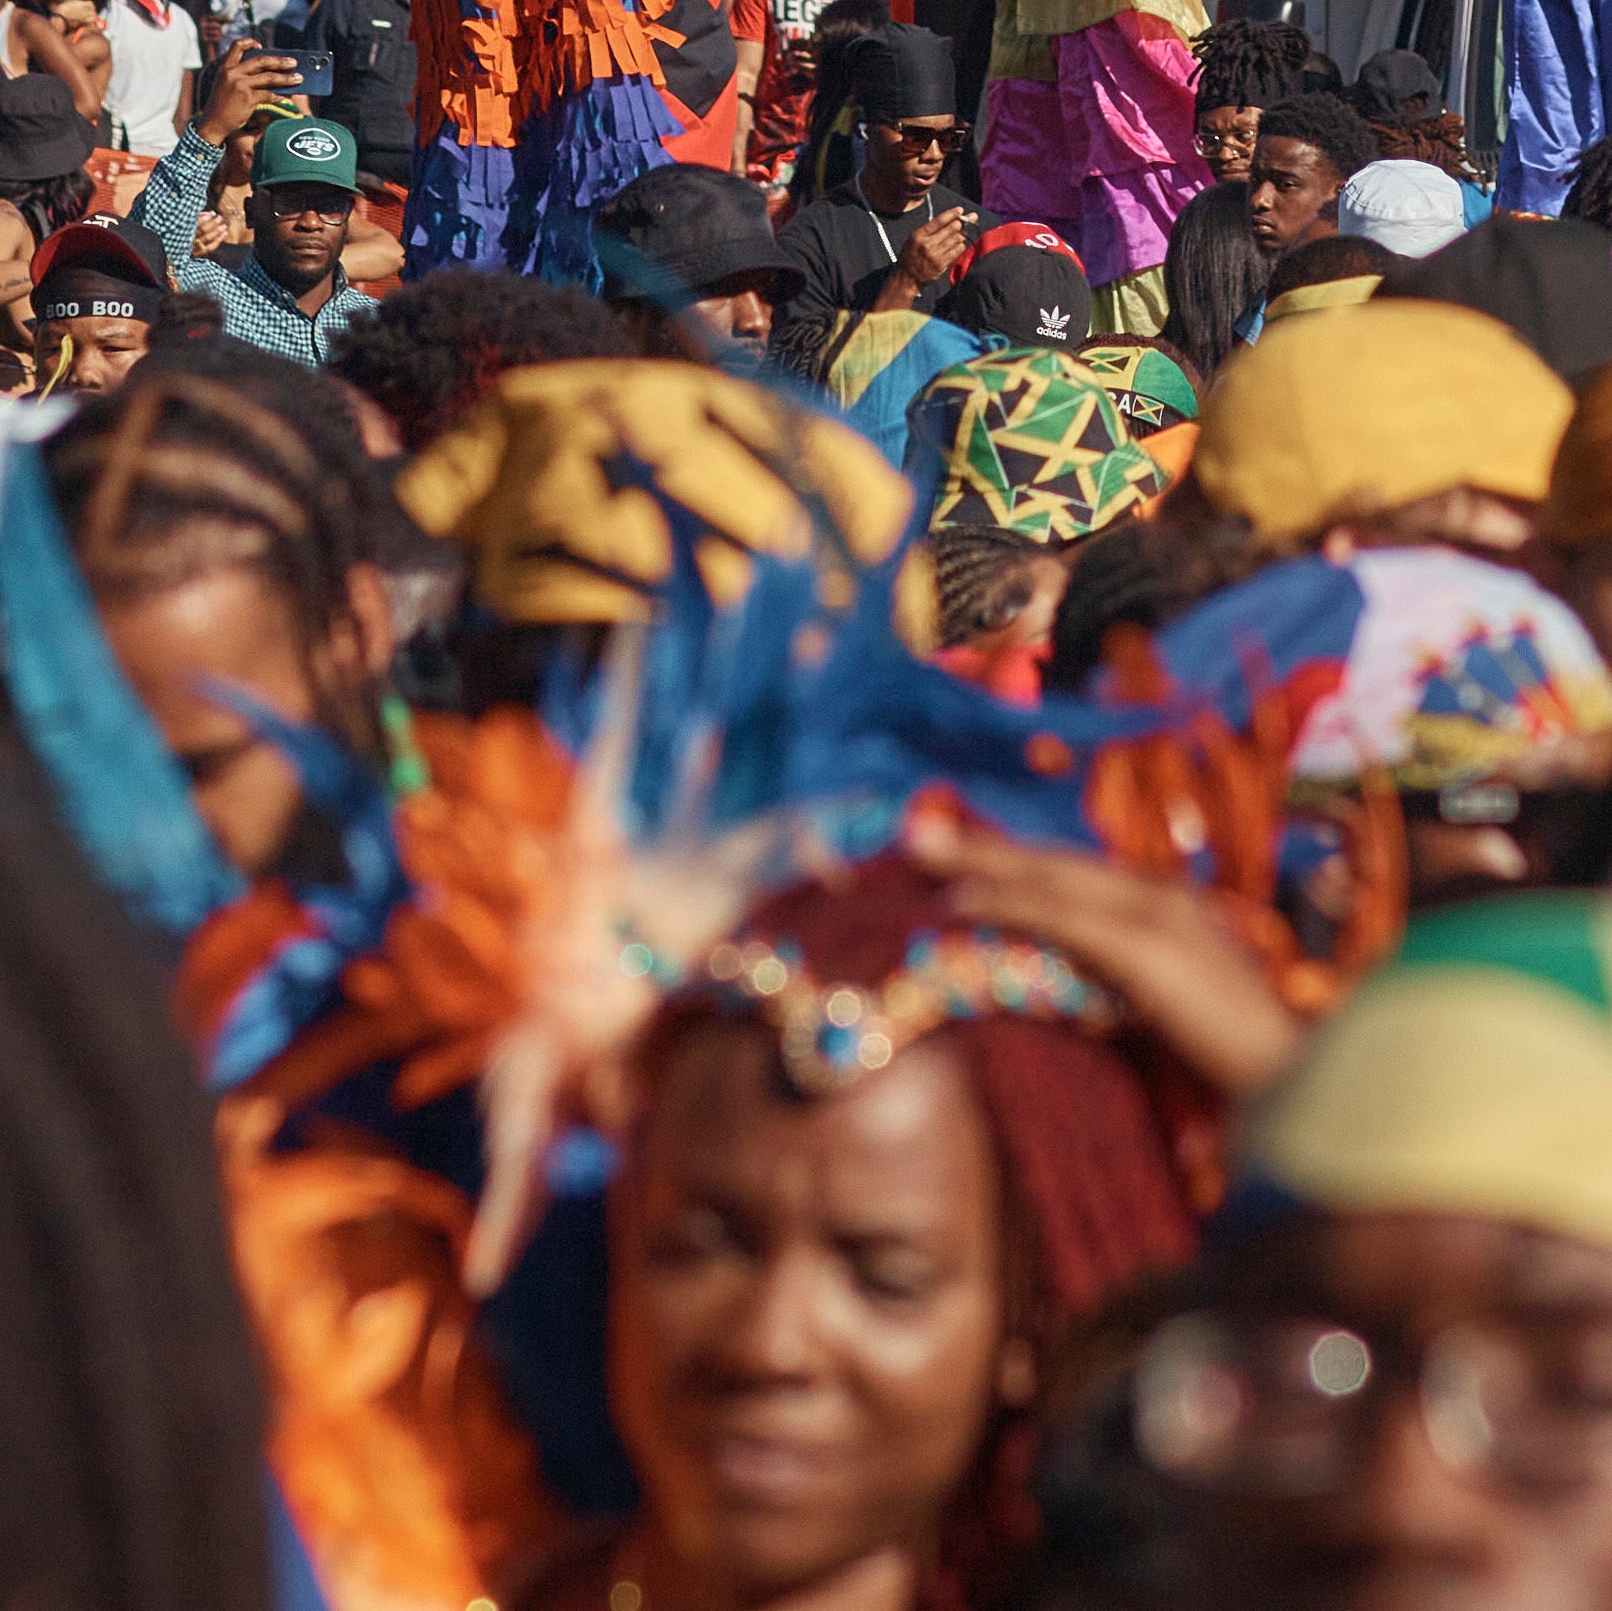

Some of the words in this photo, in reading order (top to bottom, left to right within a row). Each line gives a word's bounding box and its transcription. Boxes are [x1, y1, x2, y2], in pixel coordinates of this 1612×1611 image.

[293, 139, 336, 152] JETS
[46, 302, 80, 319] BOO
[92, 300, 134, 318] BOO
[1036, 326, 1067, 340] adidas
